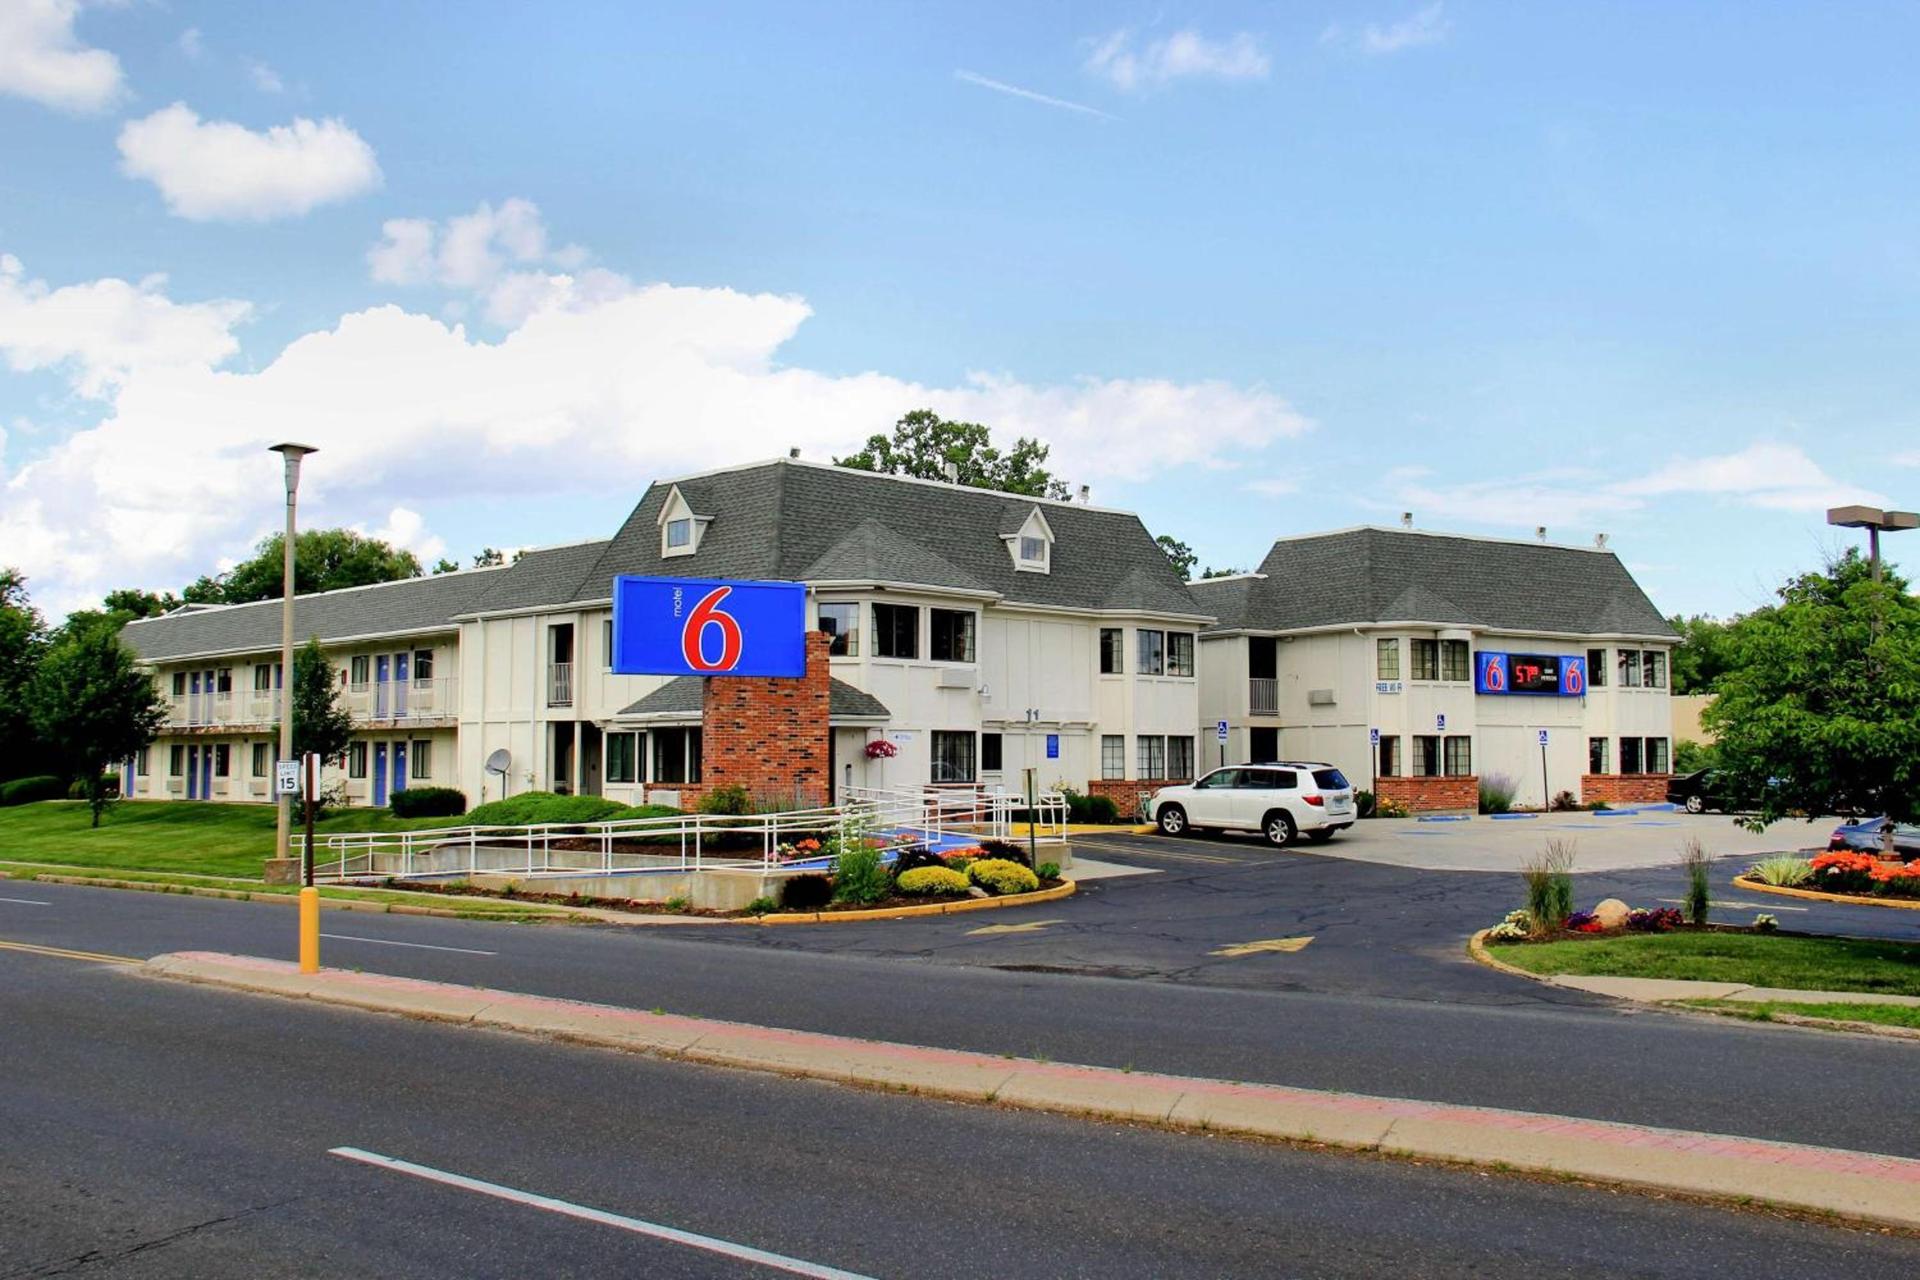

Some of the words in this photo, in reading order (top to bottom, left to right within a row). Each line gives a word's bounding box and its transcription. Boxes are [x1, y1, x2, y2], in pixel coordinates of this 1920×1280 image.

[672, 587, 683, 618] motel
[681, 586, 743, 671] 6
[1376, 683, 1388, 692] FREE
[1486, 656, 1505, 691] 6
[1565, 659, 1583, 694] 6
[280, 777, 296, 789] 15
